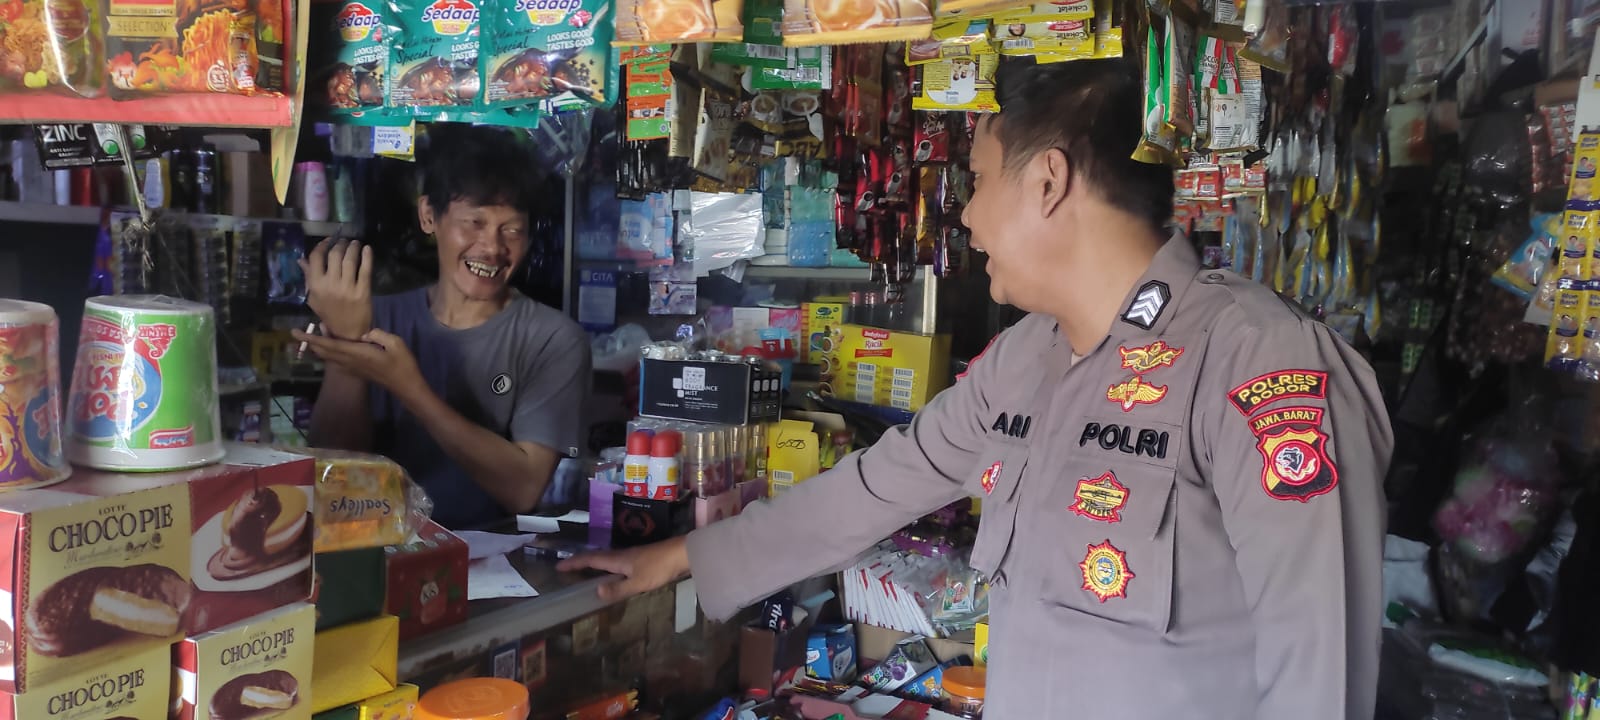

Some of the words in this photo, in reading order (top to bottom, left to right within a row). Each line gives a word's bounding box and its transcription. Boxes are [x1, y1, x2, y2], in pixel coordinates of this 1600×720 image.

[421, 6, 479, 24] Sedaap
[41, 124, 87, 142] ZINC
[1238, 374, 1318, 402] POLRES
[1251, 384, 1311, 405] BOGOR
[1255, 415, 1281, 430] JAWA
[1283, 411, 1317, 421] BARAT
[1079, 422, 1169, 459] POLRI
[98, 504, 126, 515] LOTTE
[48, 512, 137, 553] CHOCO
[139, 503, 174, 533] PIE
[220, 636, 272, 666] CHOCO
[273, 627, 294, 649] PIE
[48, 679, 116, 715] CHOCO
[118, 668, 145, 693] PIE
